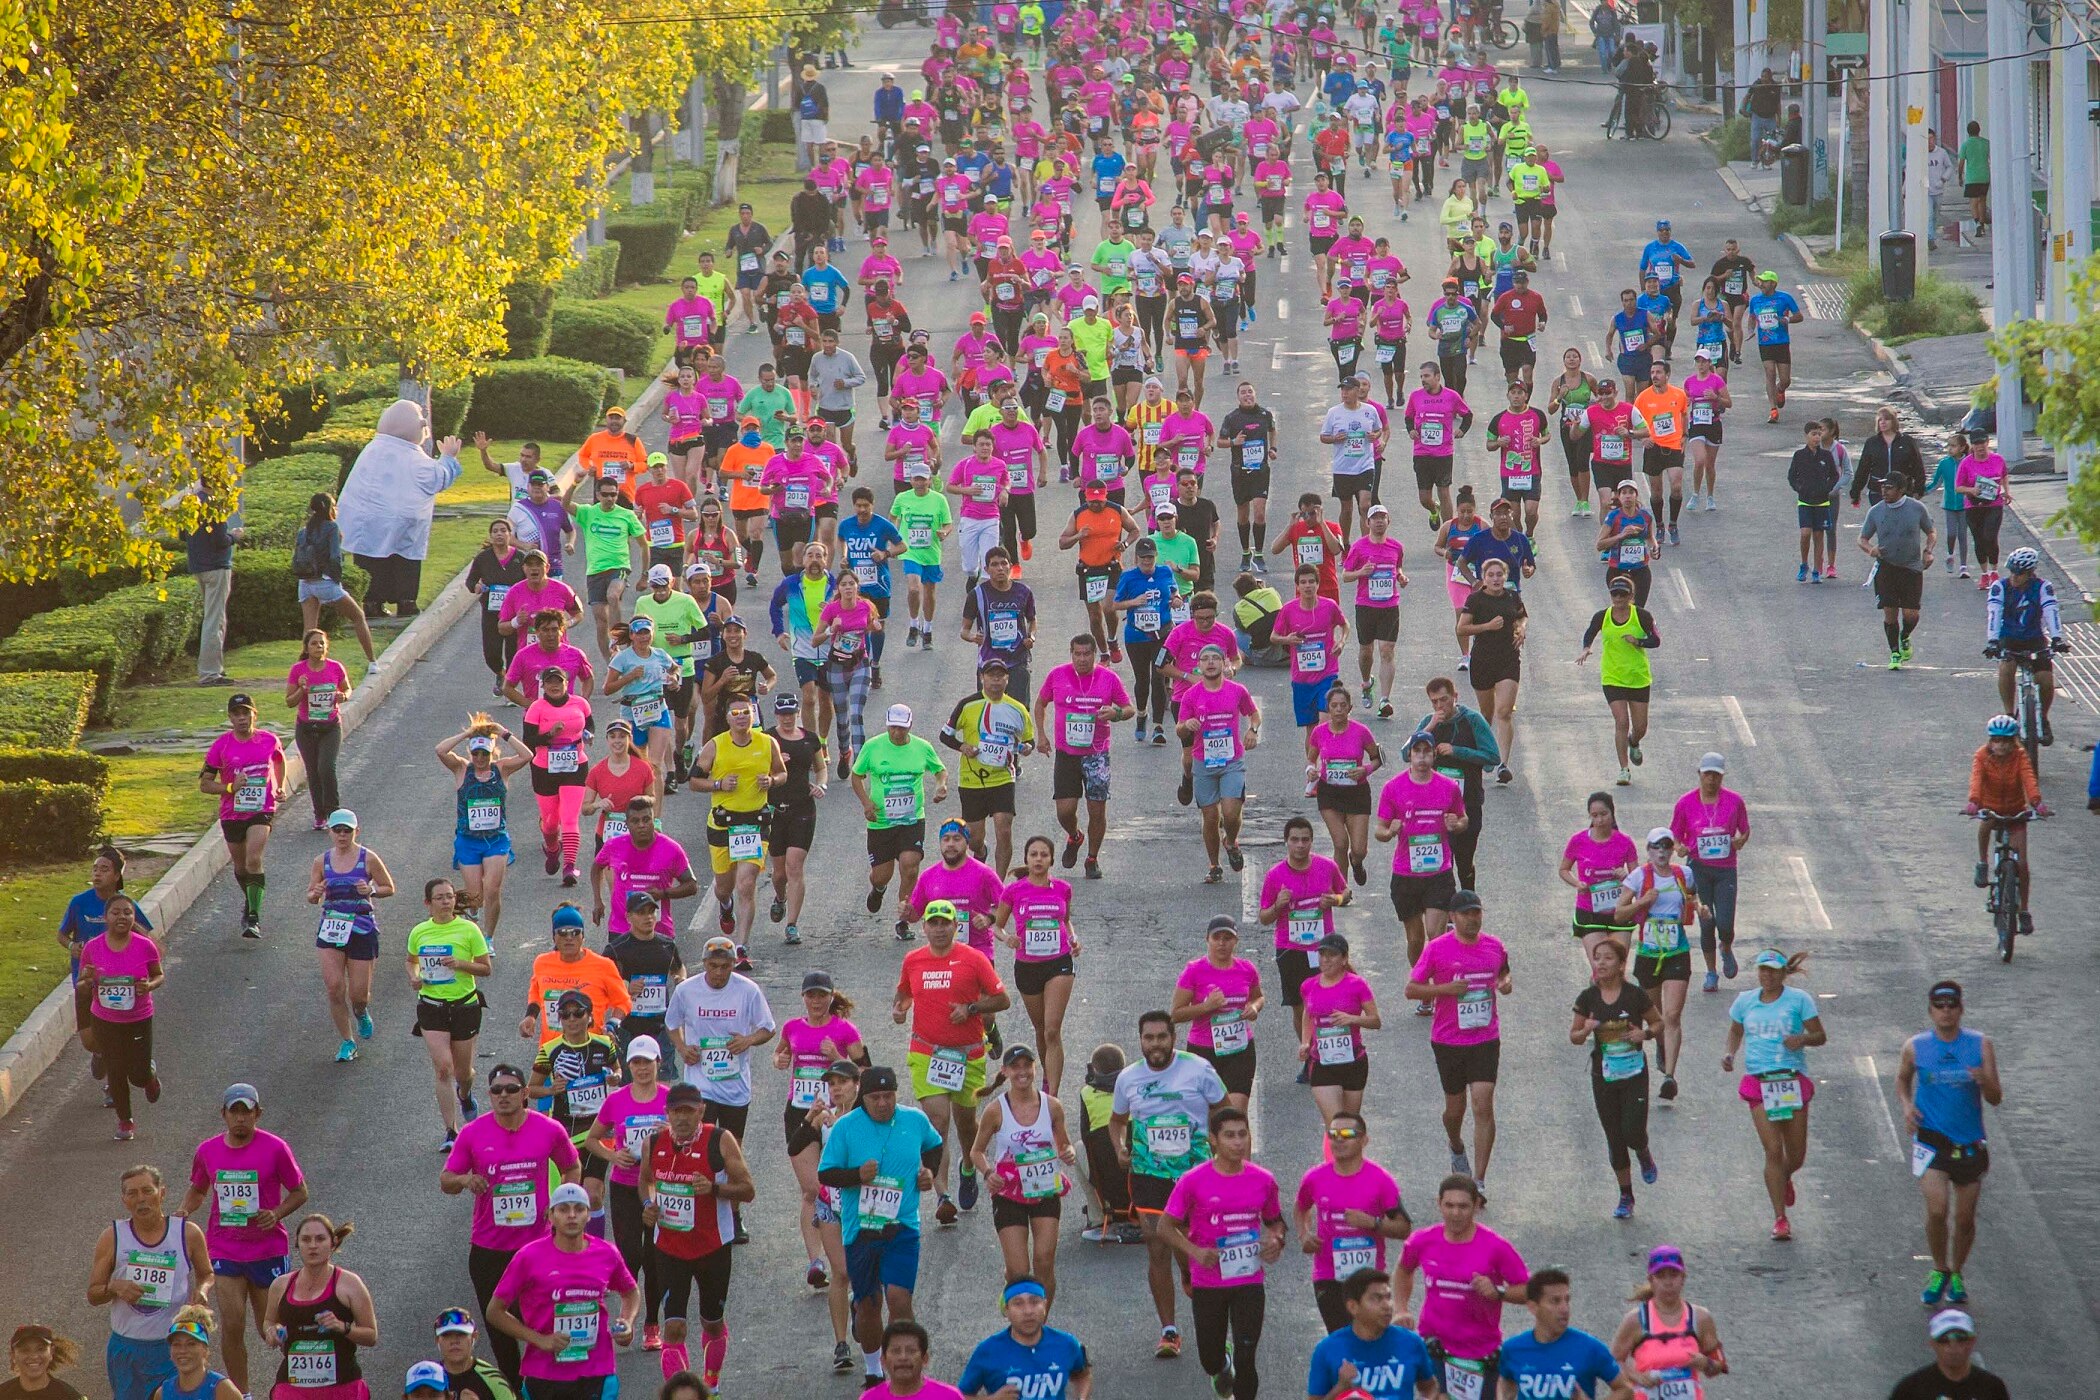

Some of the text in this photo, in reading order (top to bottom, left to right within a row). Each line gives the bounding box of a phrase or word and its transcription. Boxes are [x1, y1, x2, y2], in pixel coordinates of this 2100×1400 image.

[1182, 454, 1198, 462] 6145
[912, 530, 928, 538] 3121
[848, 537, 878, 551] RUN
[1136, 613, 1158, 622] 14033
[994, 622, 1014, 631] 8076
[1302, 652, 1322, 662] 5054
[633, 702, 659, 715] 27298
[1068, 722, 1094, 734] 14313
[1208, 738, 1228, 749] 4021
[982, 744, 1004, 756] 3069
[551, 752, 577, 762] 16053
[240, 787, 262, 798] 3263
[886, 796, 914, 808] 27197
[470, 807, 499, 818] 21180
[606, 822, 628, 832] 5105
[734, 834, 757, 846] 6187
[1700, 836, 1729, 848] 36136
[1415, 846, 1439, 856] 5226
[326, 920, 346, 932] 3166
[1294, 920, 1319, 932] 1177
[1028, 930, 1058, 942] 18251
[698, 1006, 738, 1018] brose
[1460, 1000, 1492, 1015] 26157
[1214, 1022, 1245, 1038] 26122
[1318, 1037, 1350, 1050] 26150
[706, 1050, 734, 1062] 4274
[930, 1058, 964, 1076] 26124
[795, 1080, 826, 1094] 21151
[1767, 1082, 1795, 1094] 4184
[571, 1087, 604, 1103] 15061
[1151, 1128, 1187, 1142] 14295
[656, 1168, 668, 1180] Red
[1026, 1162, 1054, 1178] 6123
[223, 1184, 252, 1198] 3183
[864, 1188, 900, 1204] 19109
[500, 1196, 530, 1210] 3199
[659, 1194, 692, 1211] 14298
[1220, 1244, 1260, 1264] 28132
[1340, 1252, 1372, 1266] 3109
[132, 1268, 168, 1284] 3188
[558, 1315, 598, 1331] 11314
[291, 1356, 332, 1370] 23166
[1518, 1373, 1577, 1399] RUN
